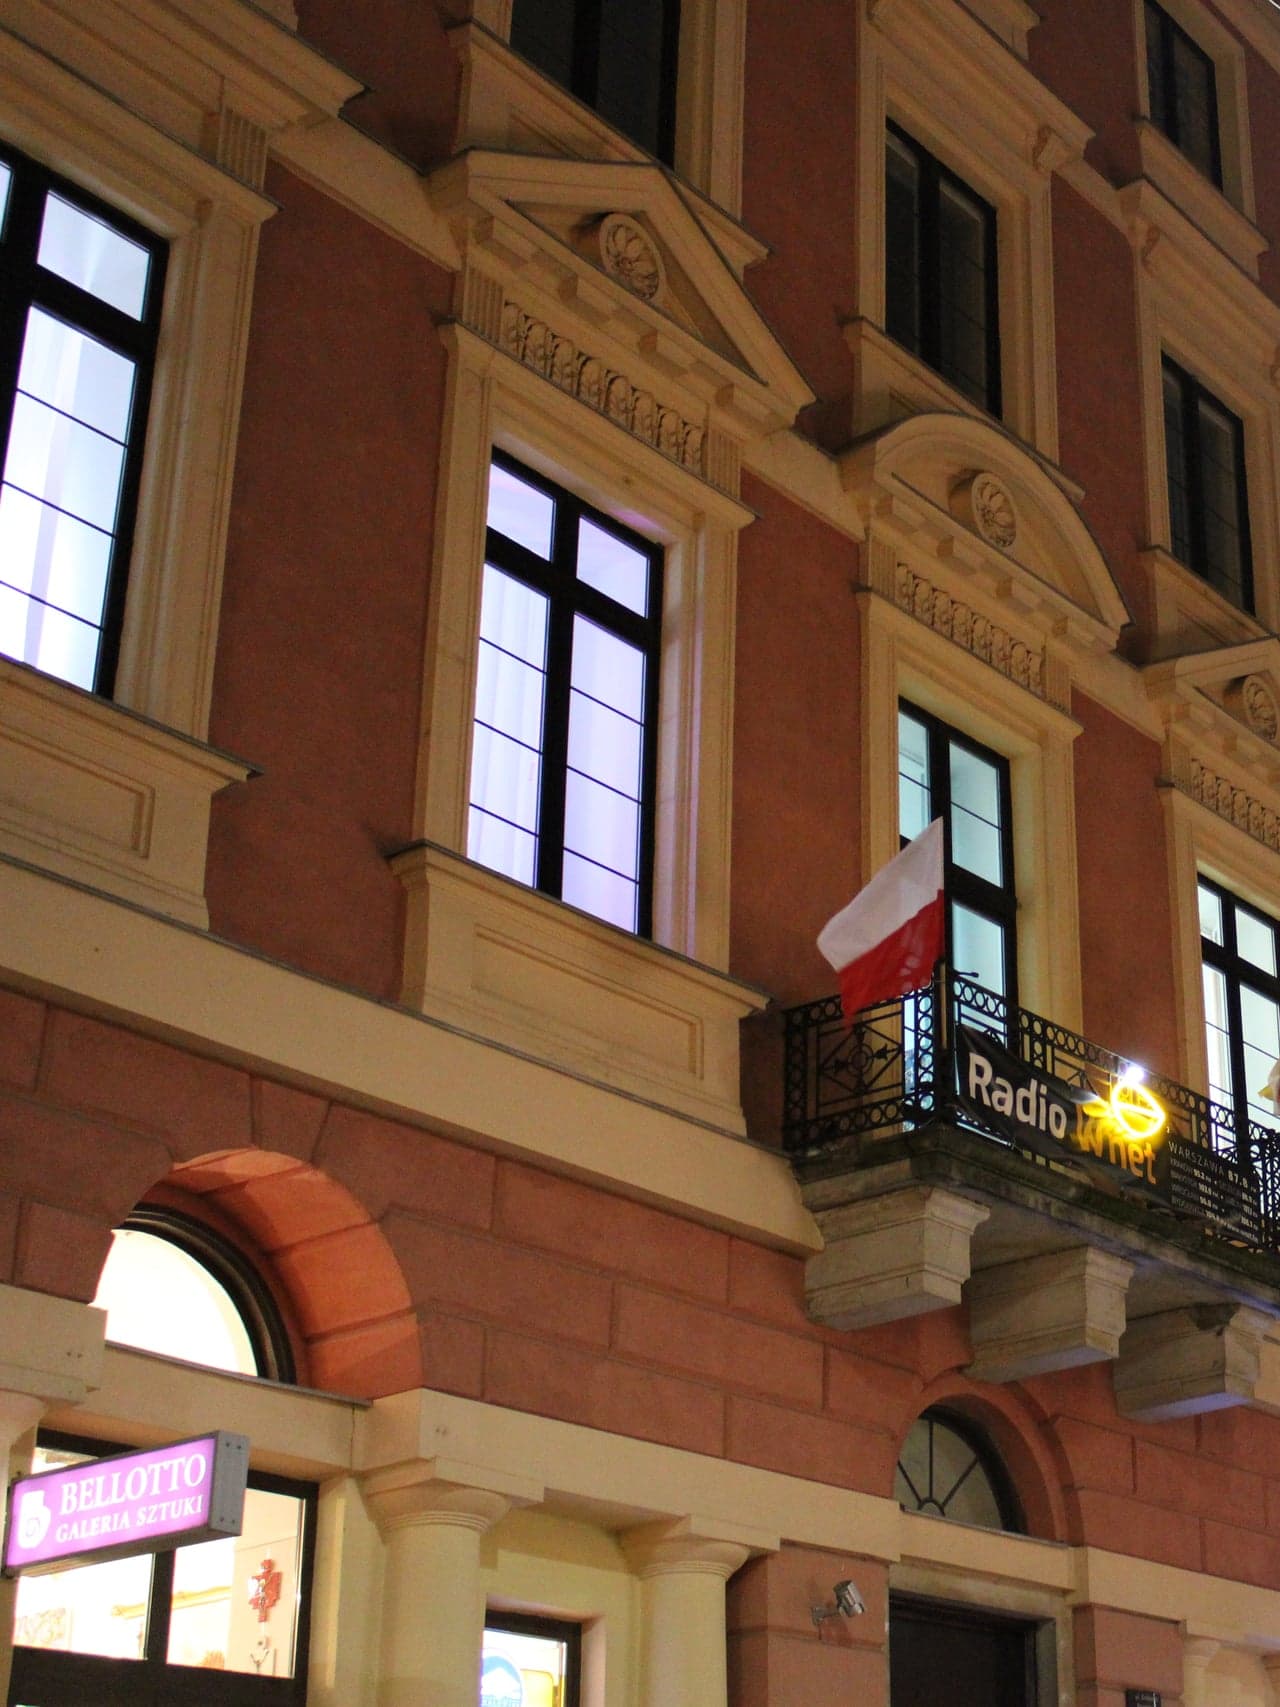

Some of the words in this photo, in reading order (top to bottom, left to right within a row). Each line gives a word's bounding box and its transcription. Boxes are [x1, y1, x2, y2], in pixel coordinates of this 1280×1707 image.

[968, 1052, 1068, 1140] Radio
[1075, 1103, 1157, 1185] Wnet
[1168, 1140, 1225, 1176] WARSZAWA
[1227, 1168, 1249, 1189] 87.8
[59, 1453, 207, 1516] BELLOTTO
[56, 1510, 131, 1543] GALERIA
[136, 1494, 204, 1527] SZTUKI
